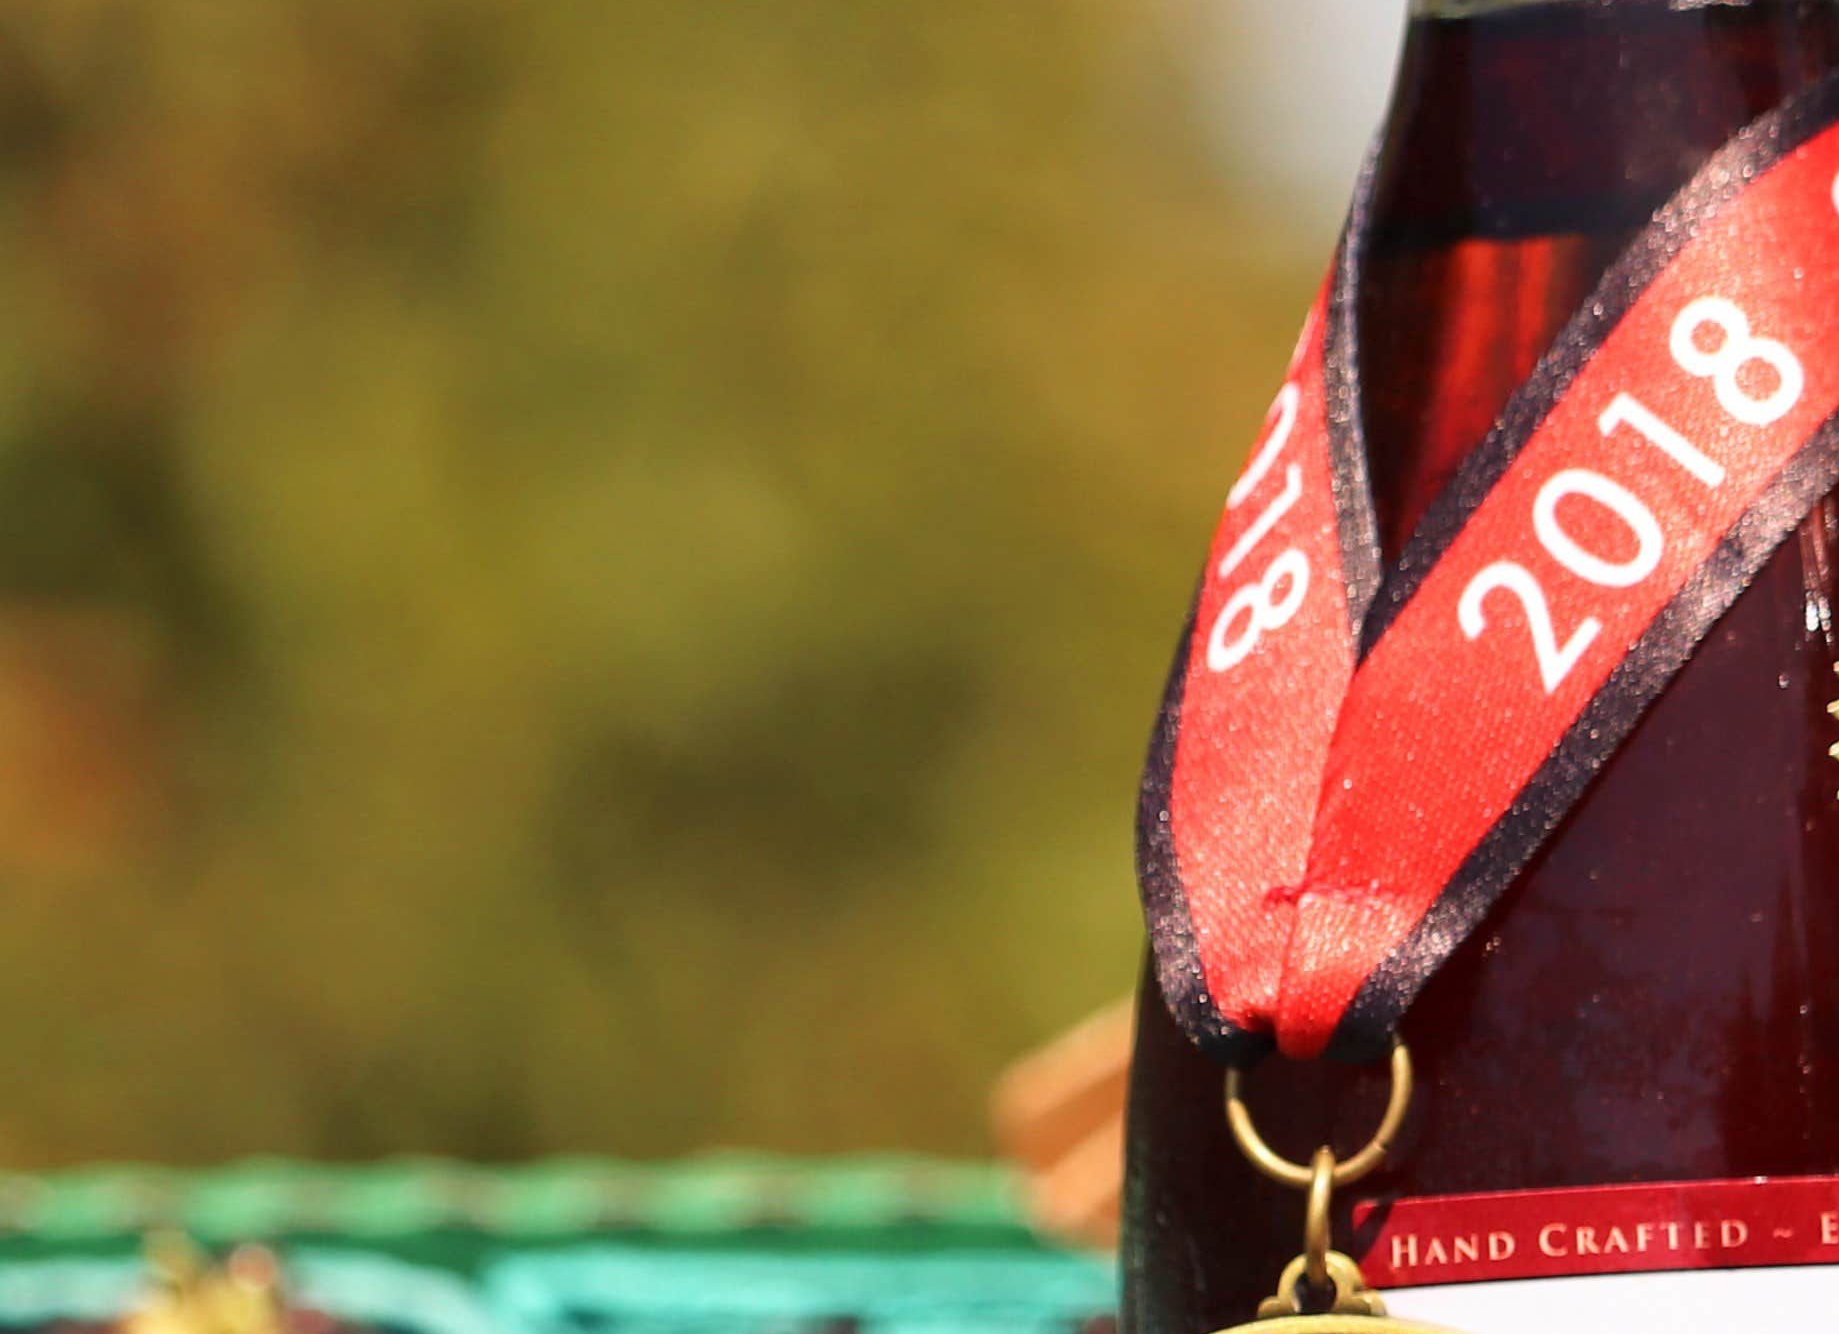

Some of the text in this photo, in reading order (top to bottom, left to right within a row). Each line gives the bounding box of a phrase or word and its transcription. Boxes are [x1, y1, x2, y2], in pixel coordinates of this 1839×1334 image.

[1457, 293, 1804, 695] 2018
[1391, 1232, 1516, 1268] HAND
[1539, 1219, 1749, 1257] CRAFTED
